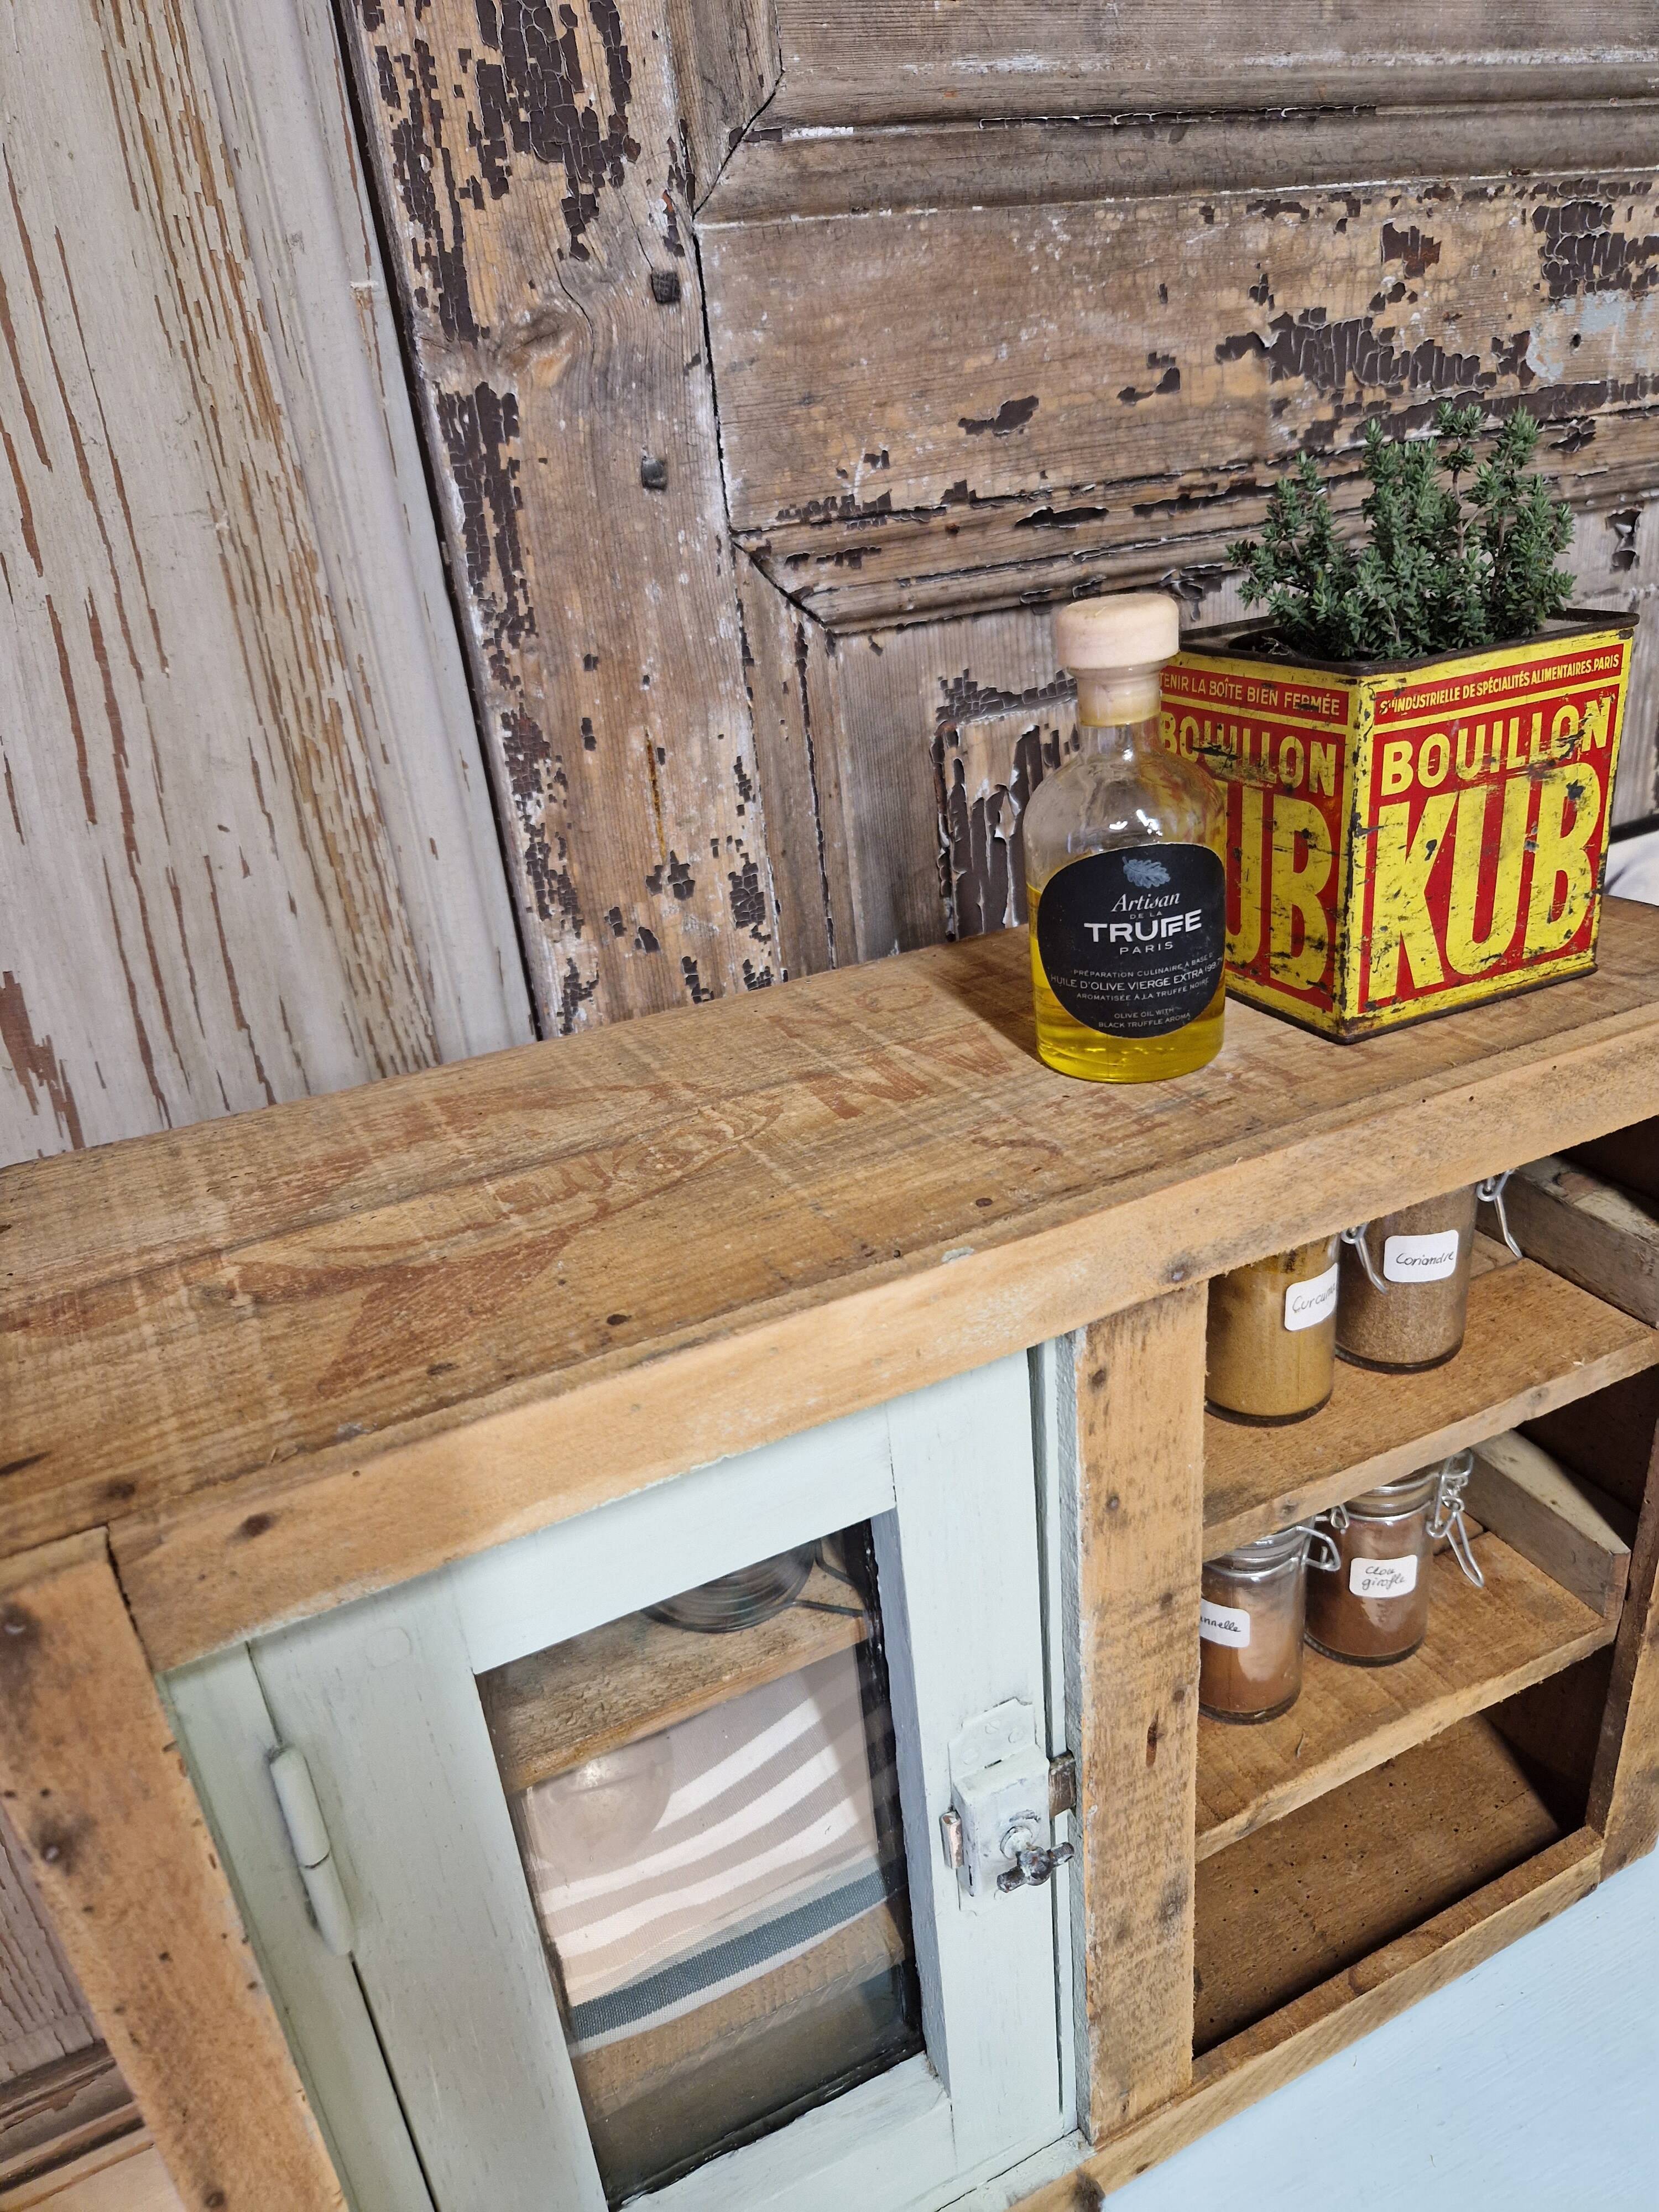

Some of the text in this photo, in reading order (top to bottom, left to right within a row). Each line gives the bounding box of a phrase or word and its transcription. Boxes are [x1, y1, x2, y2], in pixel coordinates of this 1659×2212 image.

[1192, 677, 1206, 695] LA
[1209, 677, 1243, 701] BOÎTE
[1248, 686, 1278, 706] BIEN
[1394, 686, 1460, 713] INDUSTRIELLE
[1463, 683, 1476, 700] DE
[1477, 670, 1531, 696] SPÉCIALITÉS
[1381, 697, 1611, 796] BOUILLON
[1215, 779, 1332, 990] UB
[1369, 762, 1601, 1003] KUB
[1110, 893, 1180, 912] Artisan
[1083, 909, 1202, 943] TRUFFE
[1119, 941, 1173, 956] PARIS
[1073, 969, 1134, 978] PRÉPARATION
[1136, 964, 1183, 977] CULINAIRE
[1191, 954, 1208, 966] BASE
[1050, 974, 1078, 988] HUILE
[1079, 980, 1125, 991] D'OLIVE
[1128, 977, 1171, 990] VIERGE
[1173, 968, 1204, 984] EXTRA
[1076, 993, 1131, 1001] AROMATISÉE
[1156, 986, 1188, 998] TRUFFE
[1190, 977, 1209, 990] NOIRE
[1128, 1019, 1164, 1028] TRUFFLE
[1165, 1013, 1191, 1022] AROMA
[1155, 1007, 1175, 1016] WITH
[1396, 1251, 1454, 1266] Coriandre
[1361, 1573, 1405, 1590] girofle
[1200, 1615, 1241, 1632] nnelle
